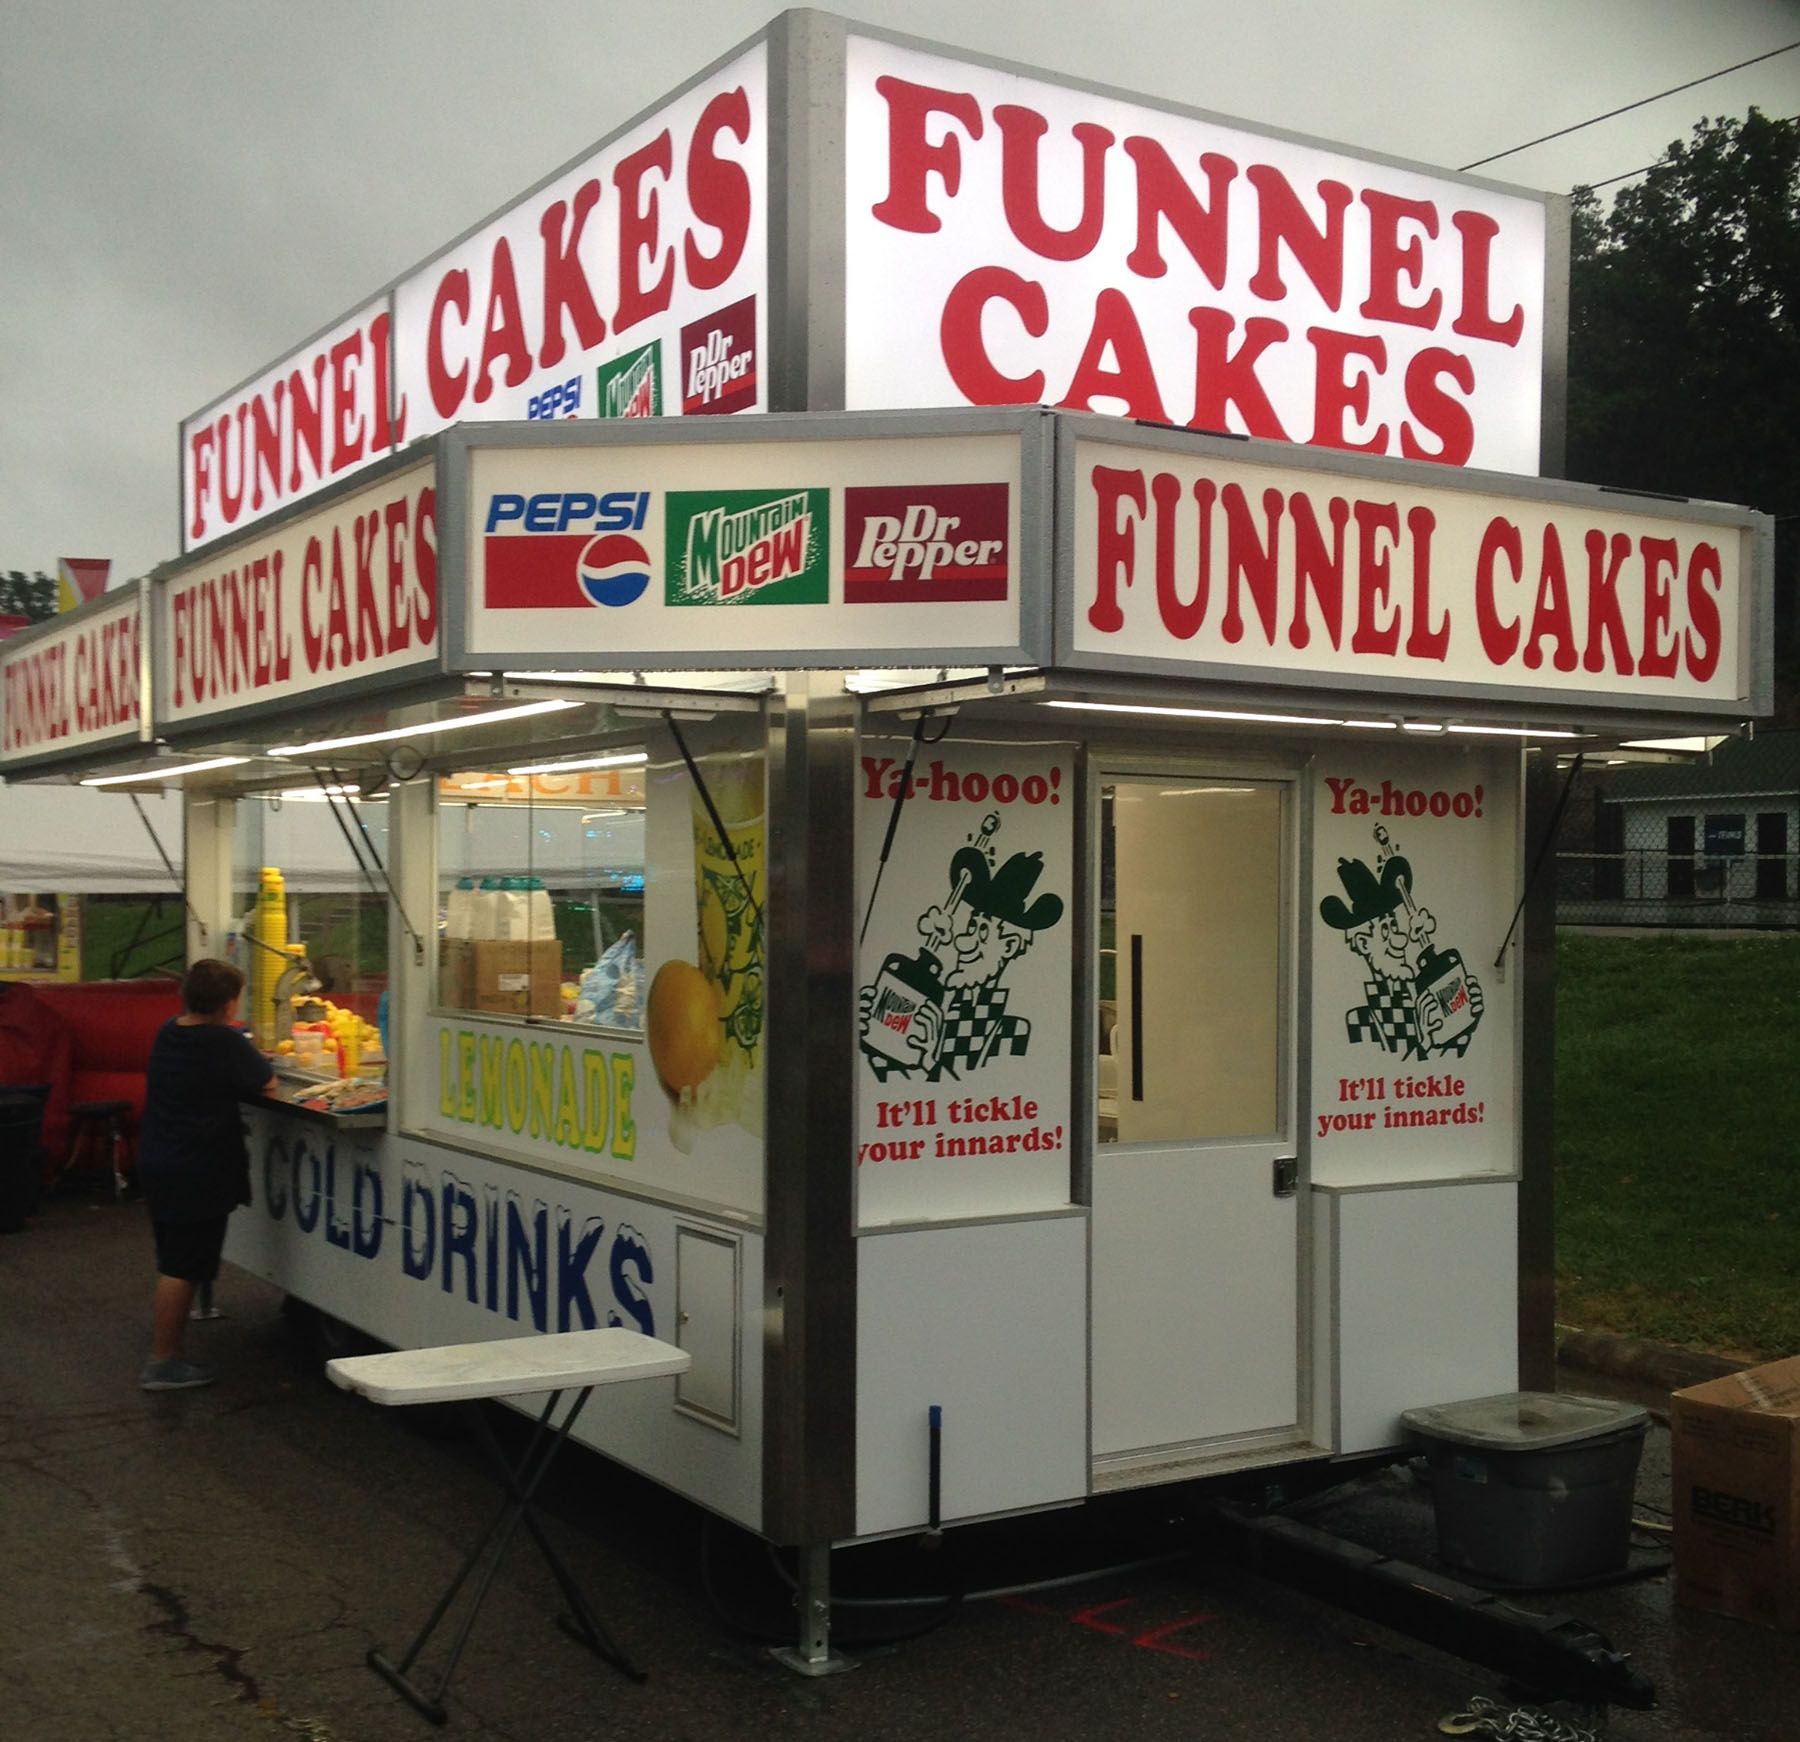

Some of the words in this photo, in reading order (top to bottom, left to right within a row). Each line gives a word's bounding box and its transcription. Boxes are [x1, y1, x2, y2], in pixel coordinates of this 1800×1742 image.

[872, 74, 1525, 348] FUNNEL
[190, 311, 408, 540] FUNNEL
[425, 84, 752, 420] CAKES
[707, 328, 734, 362] Dr
[939, 265, 1476, 469] CAKES
[528, 374, 583, 420] PEPSI
[686, 345, 753, 405] Pepper
[484, 491, 651, 533] PEPSI
[899, 504, 961, 541] Dr
[852, 515, 1004, 581] Pepper
[172, 548, 292, 709] FUNNEL
[301, 485, 437, 675] CAKES
[1087, 465, 1451, 663] FUNNEL
[1475, 515, 1722, 683] CAKES
[861, 756, 1062, 806] Ya-hooo!
[1324, 776, 1485, 819] Ya-hooo!
[439, 1027, 637, 1161] LEMONADE
[876, 1099, 937, 1129] It'll
[946, 1094, 1039, 1124] tickle
[1338, 1076, 1386, 1102] It'll
[1393, 1074, 1466, 1099] tickle
[1317, 1110, 1377, 1138] your
[1383, 1101, 1485, 1129] innards!
[857, 1137, 926, 1168] your
[934, 1124, 1064, 1159] innards!
[263, 1130, 385, 1261] COLD
[401, 1157, 656, 1339] DRINKS
